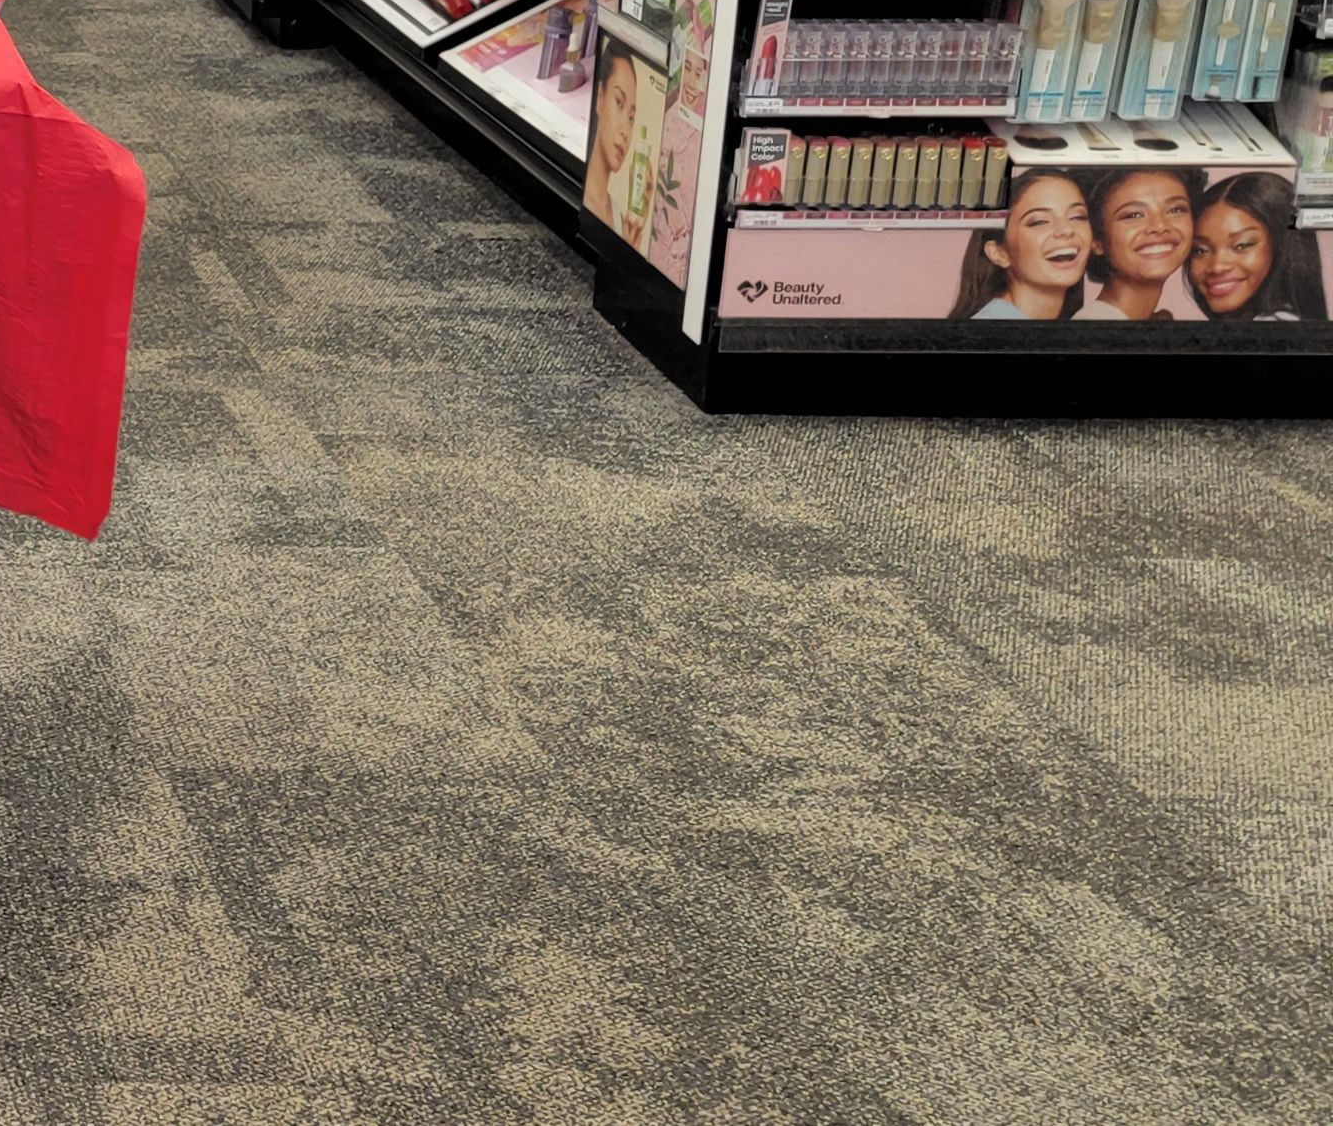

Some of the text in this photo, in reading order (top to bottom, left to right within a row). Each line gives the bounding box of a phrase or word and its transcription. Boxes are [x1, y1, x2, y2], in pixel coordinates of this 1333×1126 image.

[753, 137, 774, 147] High
[752, 145, 784, 155] Impact
[751, 153, 775, 161] Color
[774, 282, 824, 294] Beauty
